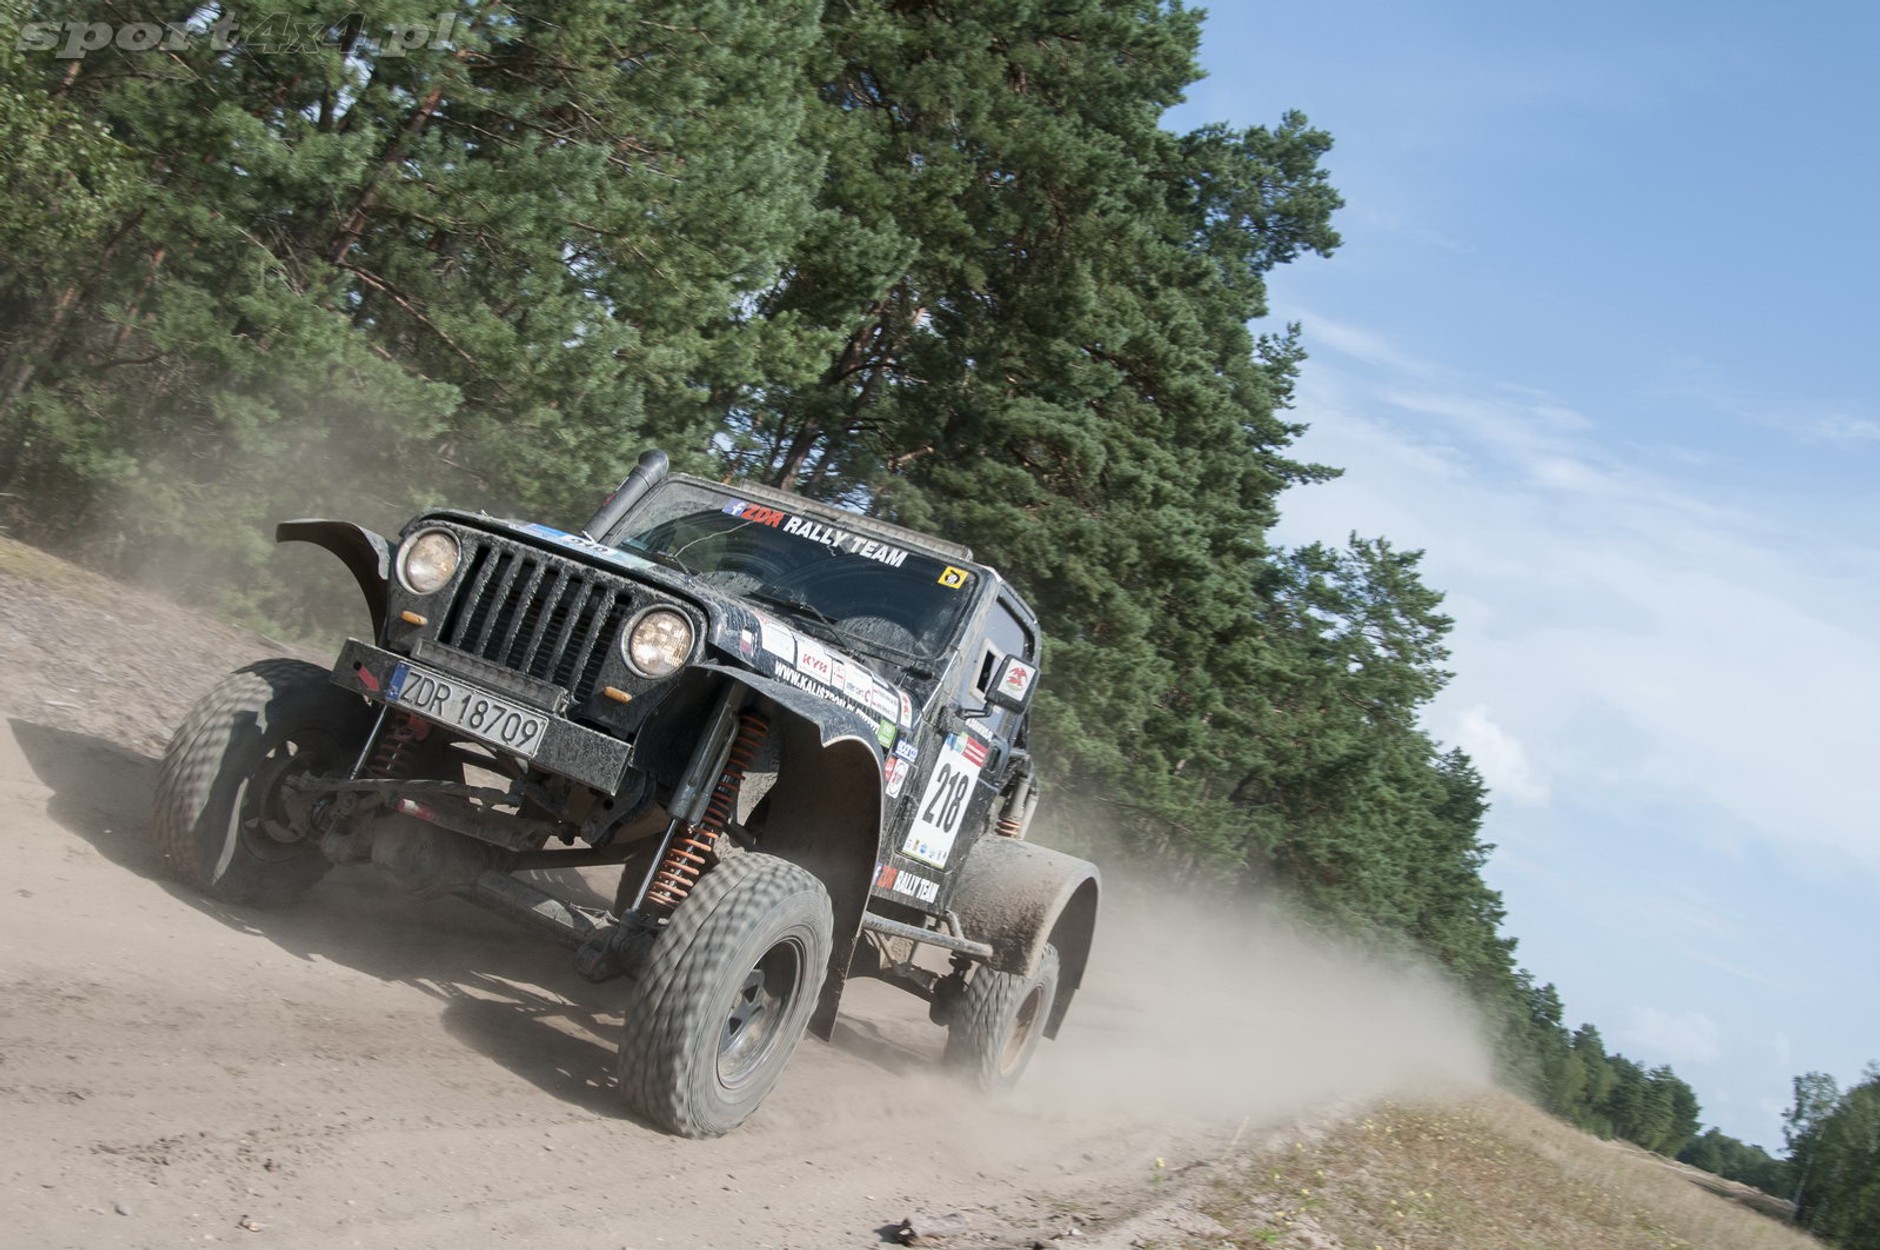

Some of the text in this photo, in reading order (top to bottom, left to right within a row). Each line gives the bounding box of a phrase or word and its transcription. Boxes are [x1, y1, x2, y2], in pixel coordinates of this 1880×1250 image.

[740, 503, 785, 528] ZDR
[782, 516, 851, 547] RALLY
[848, 536, 909, 568] TEAM
[401, 671, 540, 749] ZDR 18709
[921, 762, 970, 834] 218
